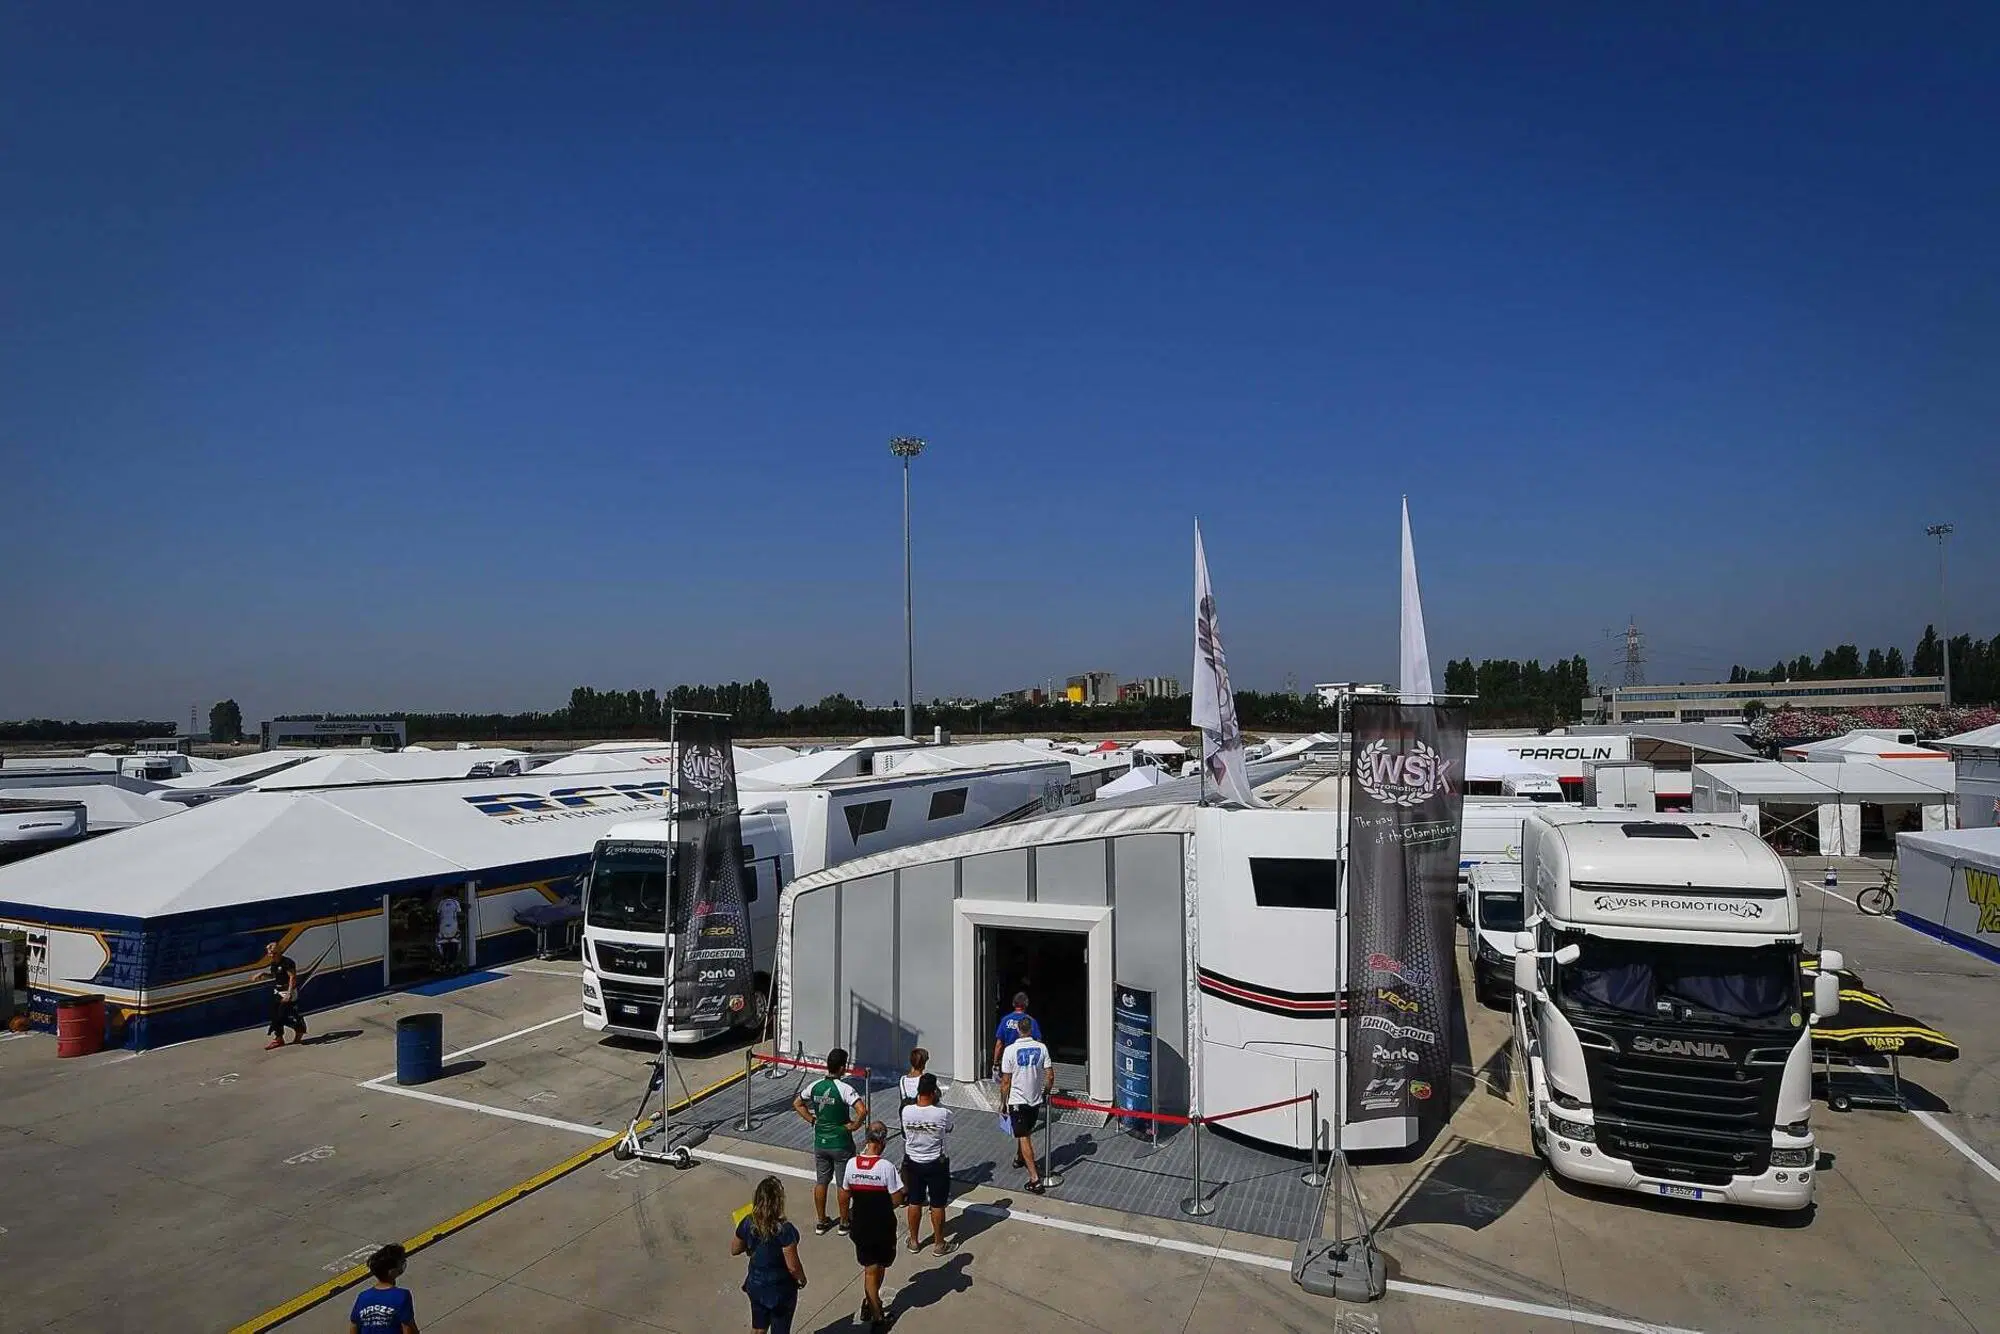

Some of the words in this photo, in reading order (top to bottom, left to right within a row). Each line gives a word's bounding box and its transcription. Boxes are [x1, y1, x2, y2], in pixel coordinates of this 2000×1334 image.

[1520, 748, 1611, 759] PAROLIN
[690, 756, 733, 783] WSK
[1370, 753, 1451, 794] WSK
[1373, 783, 1423, 793] Promotion
[501, 814, 560, 826] RICKY
[561, 807, 618, 819] FLYNN
[1616, 897, 1648, 908] WSK
[1651, 899, 1739, 912] PROMOTION
[689, 949, 745, 960] BRIDGESTONE
[1377, 988, 1419, 1013] VEGA
[1362, 1016, 1434, 1043] BRIDGESTONE
[1632, 1036, 1730, 1059] SCANIA
[1863, 1037, 1905, 1047] WARD
